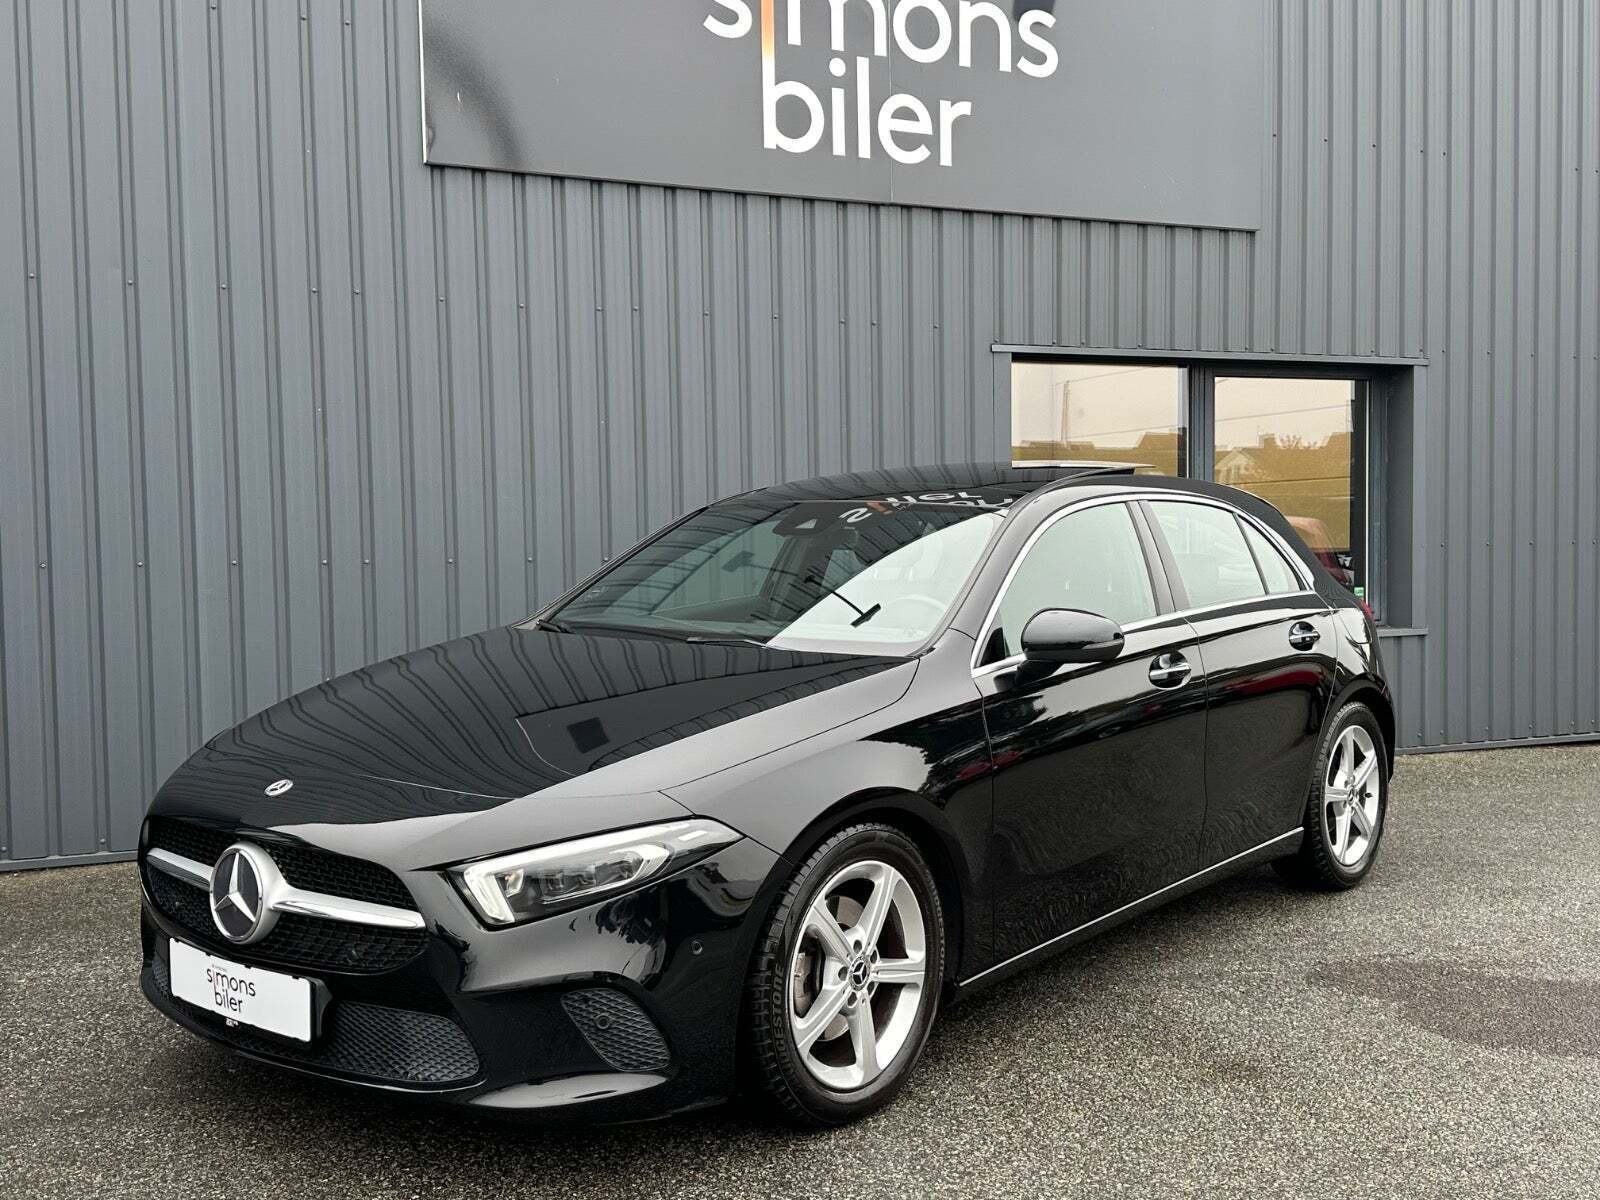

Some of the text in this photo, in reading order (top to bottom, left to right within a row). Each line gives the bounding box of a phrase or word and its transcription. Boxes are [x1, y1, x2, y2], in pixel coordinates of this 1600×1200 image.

[703, 0, 1059, 78] simons
[762, 54, 972, 166] biler
[206, 968, 256, 997] simons
[214, 987, 243, 1012] biler
